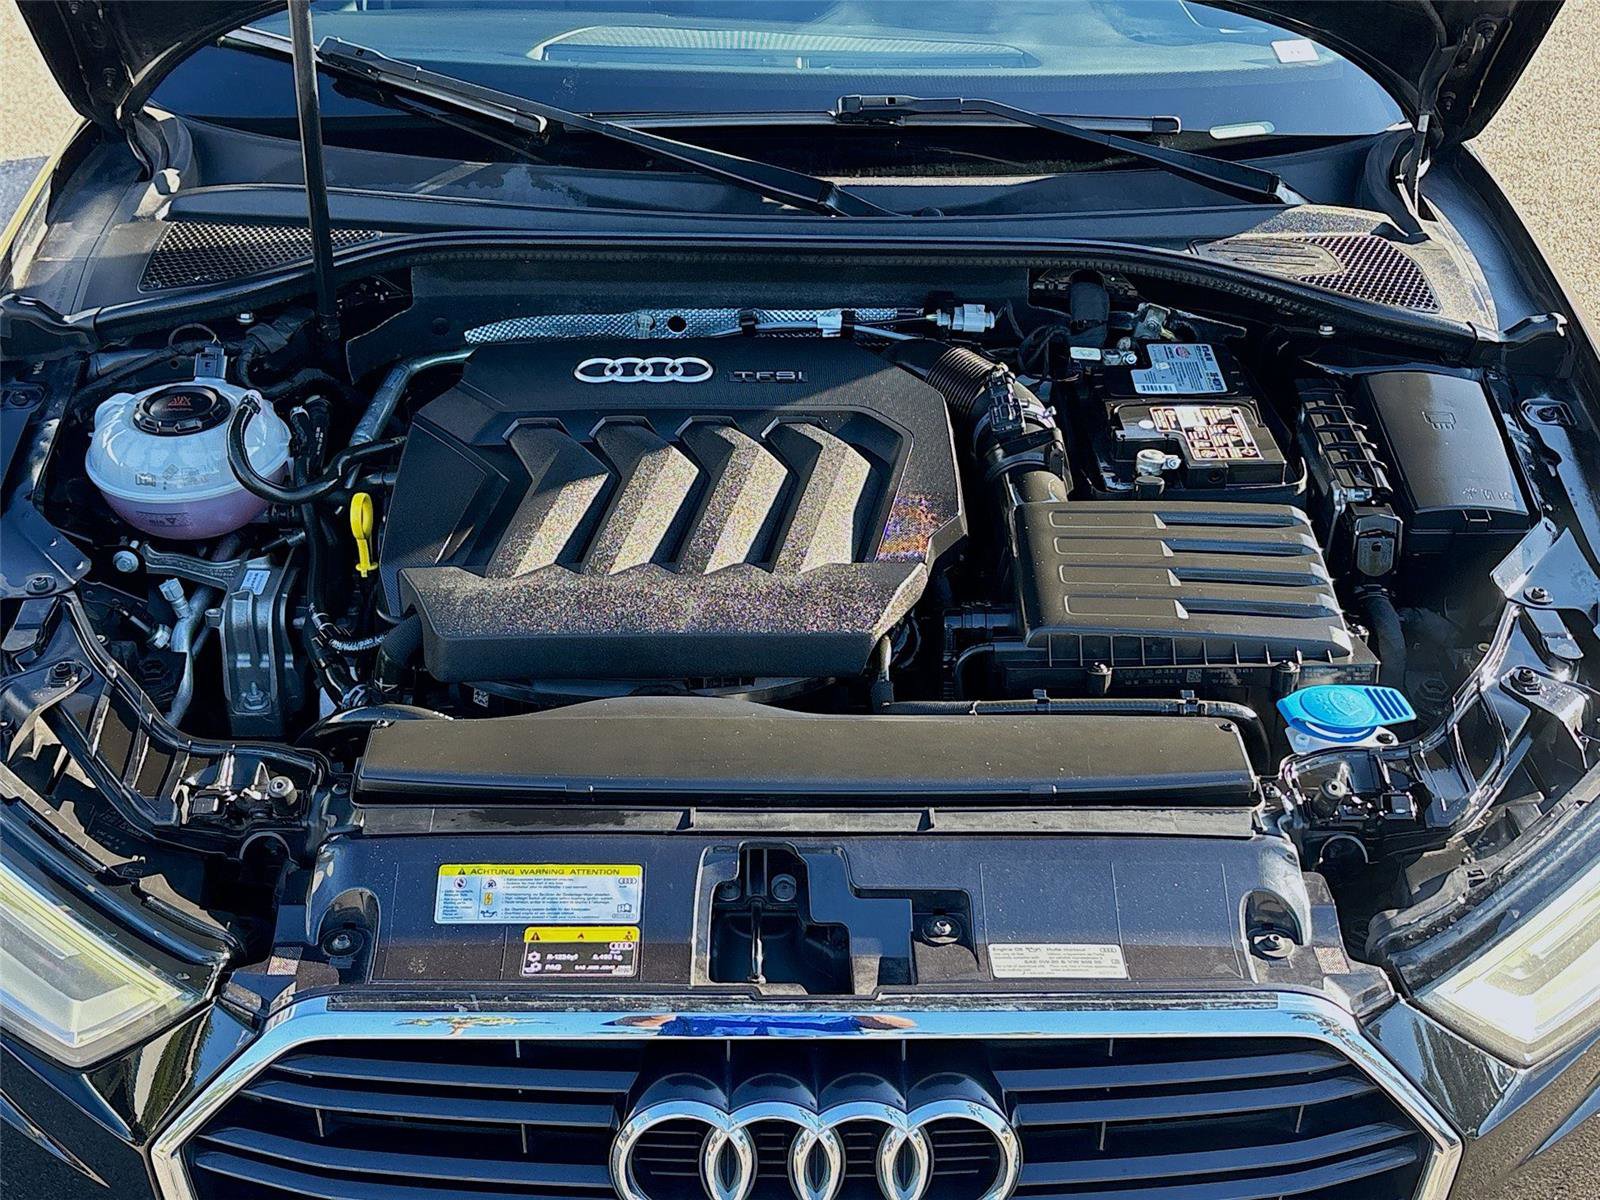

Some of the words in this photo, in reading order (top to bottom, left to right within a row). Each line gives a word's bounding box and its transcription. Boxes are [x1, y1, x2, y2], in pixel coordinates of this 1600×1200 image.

[733, 371, 803, 381] TFSI
[470, 868, 515, 876] ACHTUNG
[520, 868, 564, 876] WARNING
[570, 868, 620, 876] ATTENTION
